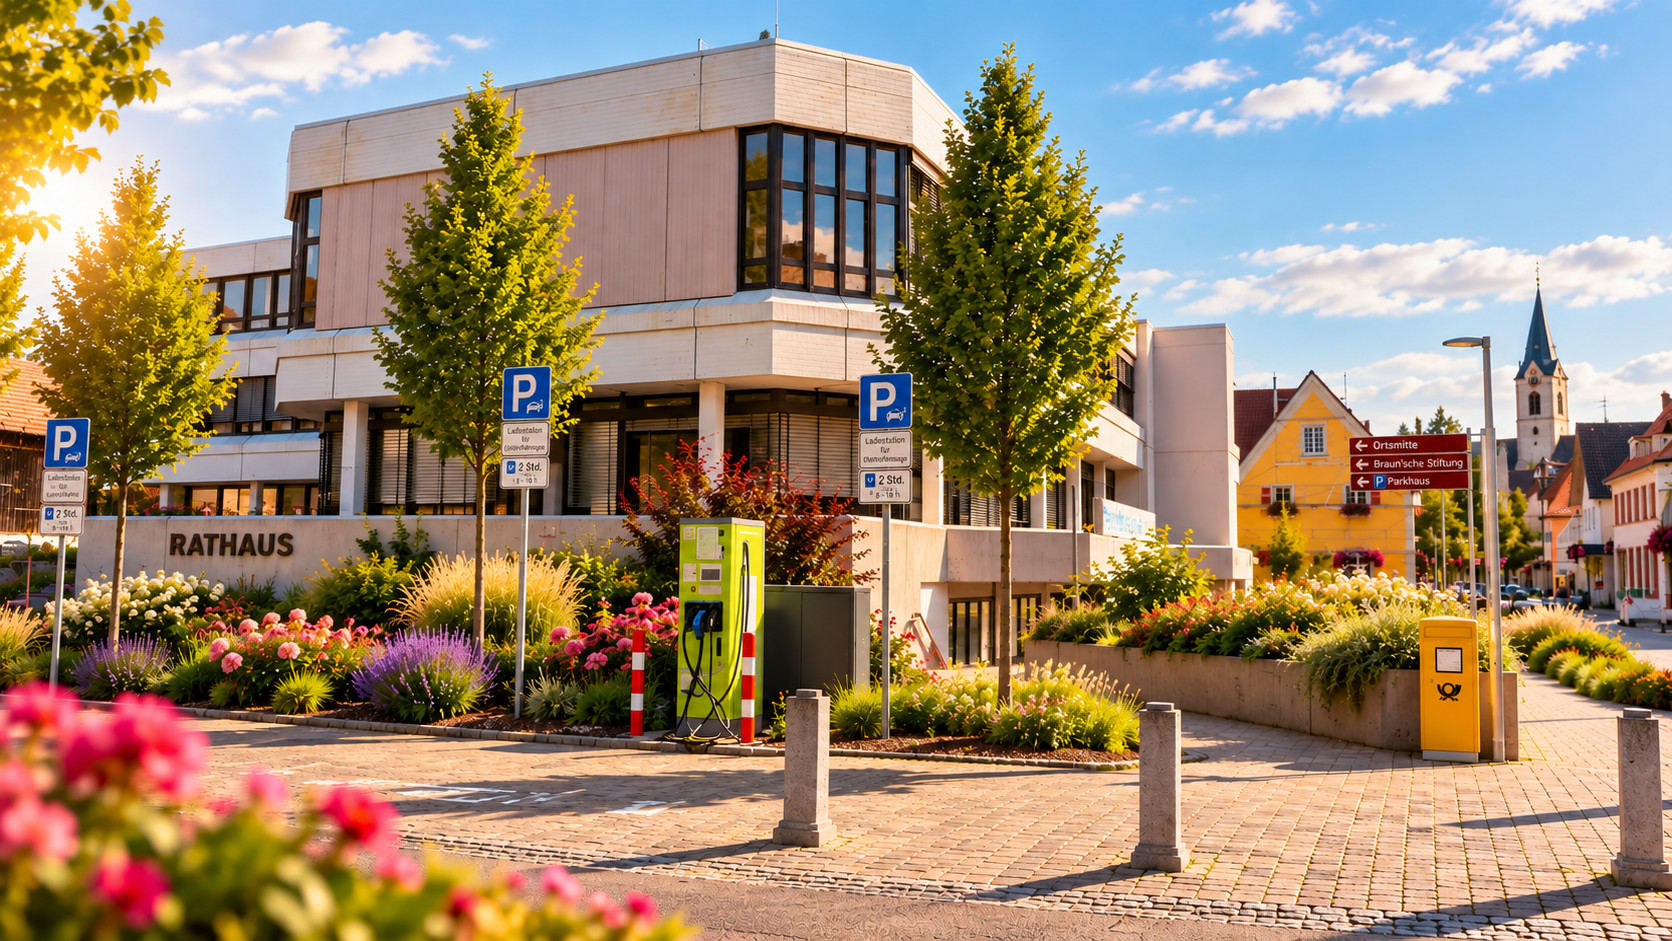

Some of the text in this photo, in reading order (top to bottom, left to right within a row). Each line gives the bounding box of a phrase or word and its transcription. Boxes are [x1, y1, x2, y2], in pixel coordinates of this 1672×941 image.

[512, 374, 537, 412] P
[869, 382, 896, 421] P
[53, 425, 77, 461] P
[1373, 440, 1418, 449] Ortsmitte
[518, 462, 542, 472] 2 Std.
[1374, 458, 1463, 469] Braun'sche Stiftung
[878, 475, 905, 485] 2 Std.
[1376, 476, 1430, 488] P Parkhaus
[56, 510, 61, 519] 2
[169, 533, 294, 556] RATHAUS
